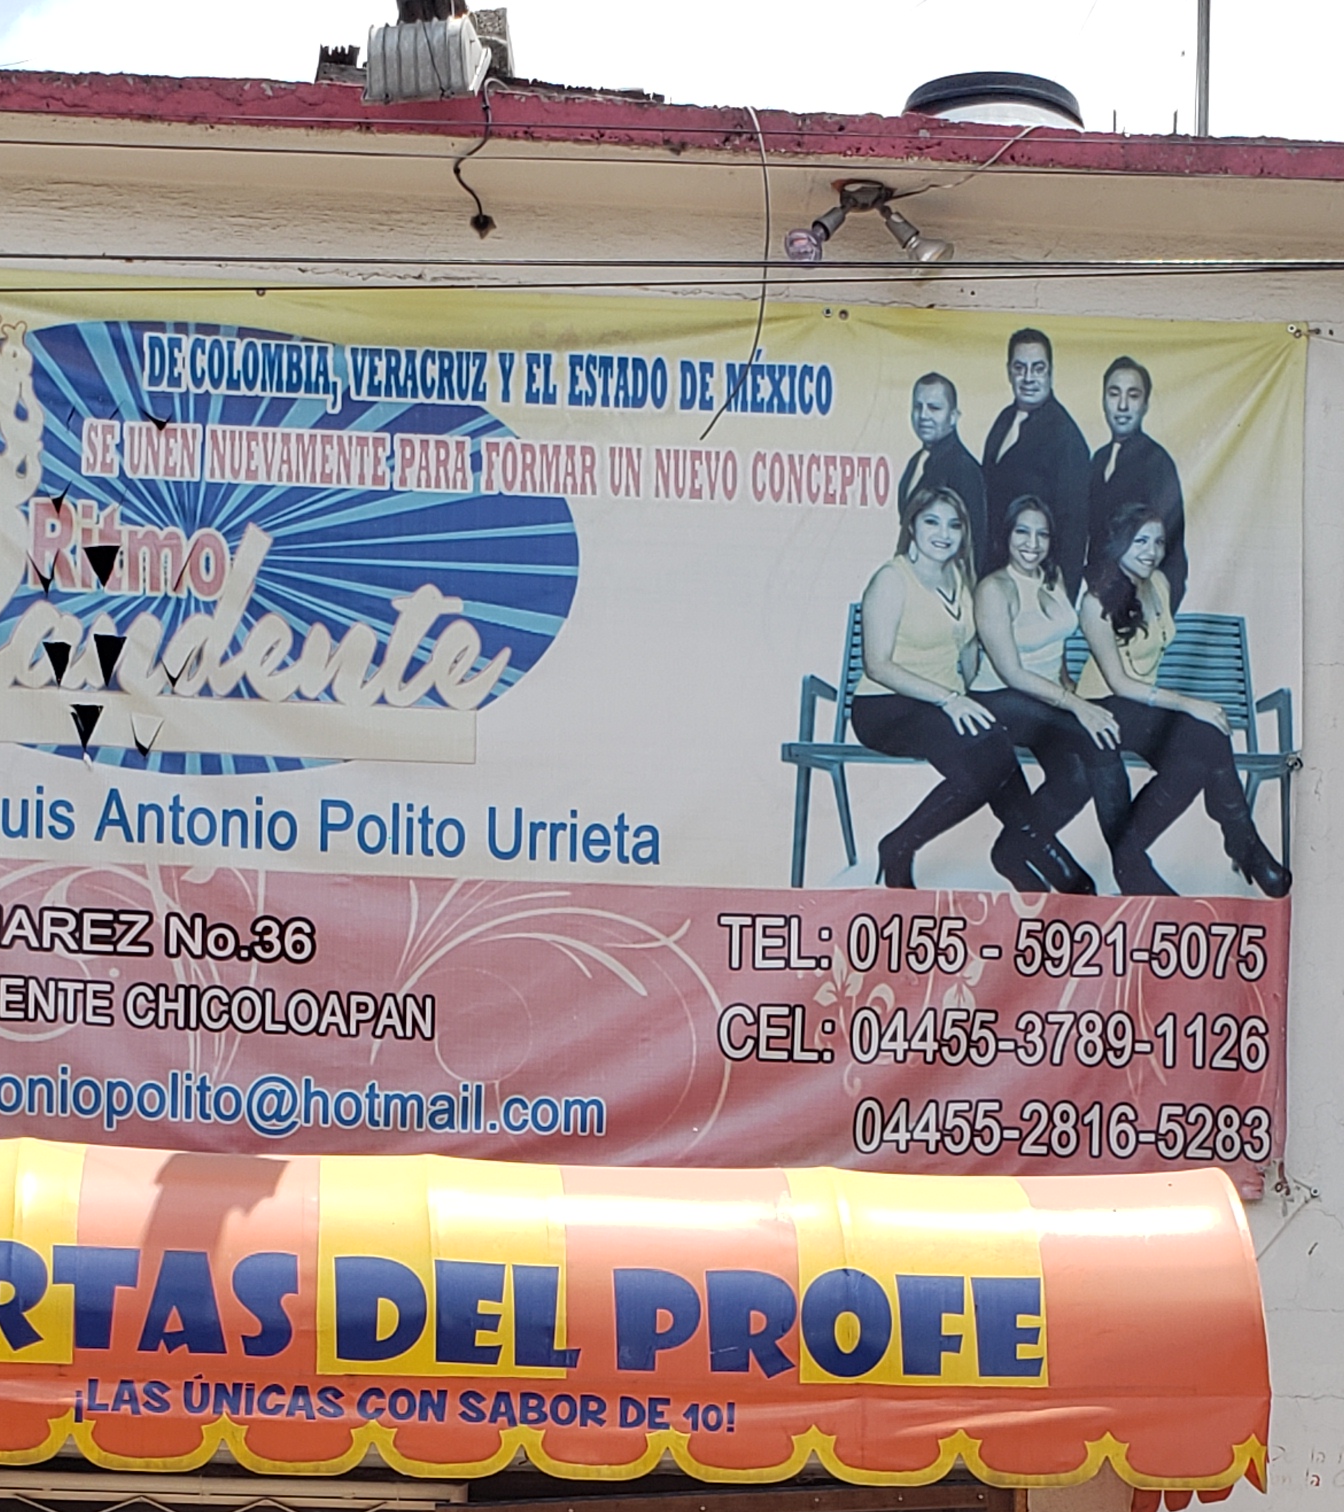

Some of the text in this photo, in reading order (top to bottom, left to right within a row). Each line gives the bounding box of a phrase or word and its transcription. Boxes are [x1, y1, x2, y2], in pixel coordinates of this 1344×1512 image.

[144, 335, 832, 416] DE COLOMBIA, VERACRUZ Y EL ESTADO DE MÉXICO
[85, 422, 891, 507] SE UNEN NUEVAMENTE PARA FORMAR UN NUEVO CONCEPTO
[30, 499, 230, 598] Ritmo
[96, 789, 299, 853] Antonio
[321, 799, 468, 858] Polito
[488, 808, 660, 866] Urrieta
[164, 911, 317, 964] No.36
[719, 915, 833, 972] TEL:
[848, 916, 968, 973] 0155
[1014, 922, 1267, 981] 5921-5075
[124, 982, 435, 1041] CHICOLOAPAN
[718, 1005, 1269, 1072] CEL: 04455-3789-1126
[856, 1098, 1272, 1162] 04455-2816-5283
[333, 1254, 583, 1371] DEL
[612, 1267, 1046, 1380] PROFE
[74, 1377, 173, 1423] ¡LAS
[356, 1386, 447, 1424] CON
[457, 1388, 608, 1431] SABOR
[619, 1396, 672, 1432] DE
[682, 1401, 736, 1435] 10!
